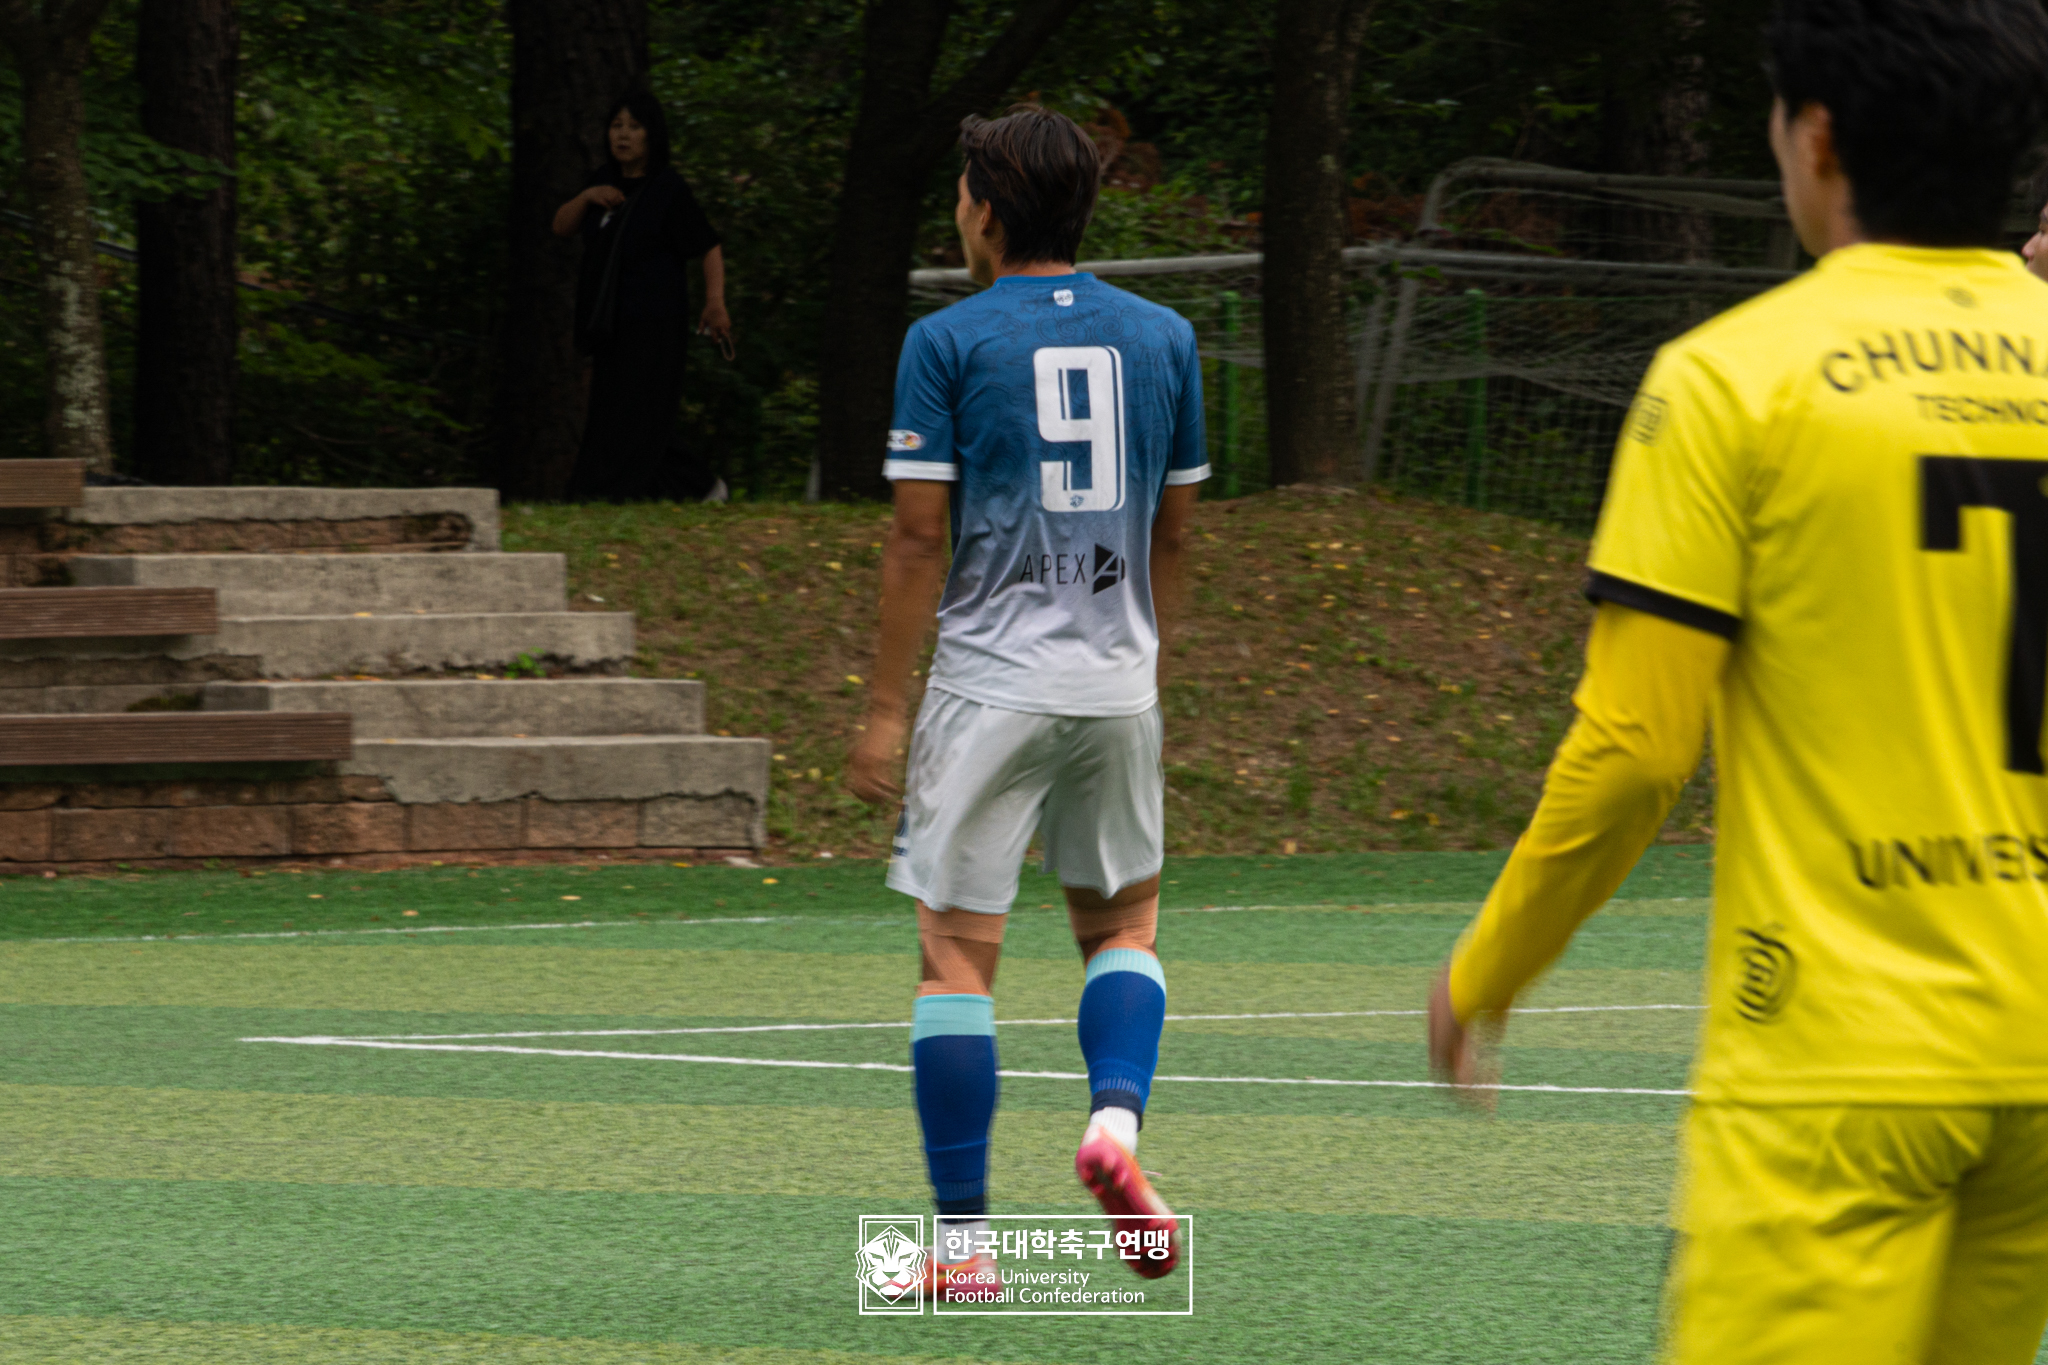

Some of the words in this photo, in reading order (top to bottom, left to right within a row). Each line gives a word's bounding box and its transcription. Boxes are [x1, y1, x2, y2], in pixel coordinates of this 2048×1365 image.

[1822, 328, 2048, 393] CHUNN
[1033, 346, 1125, 512] 9
[1020, 553, 1086, 585] APEX
